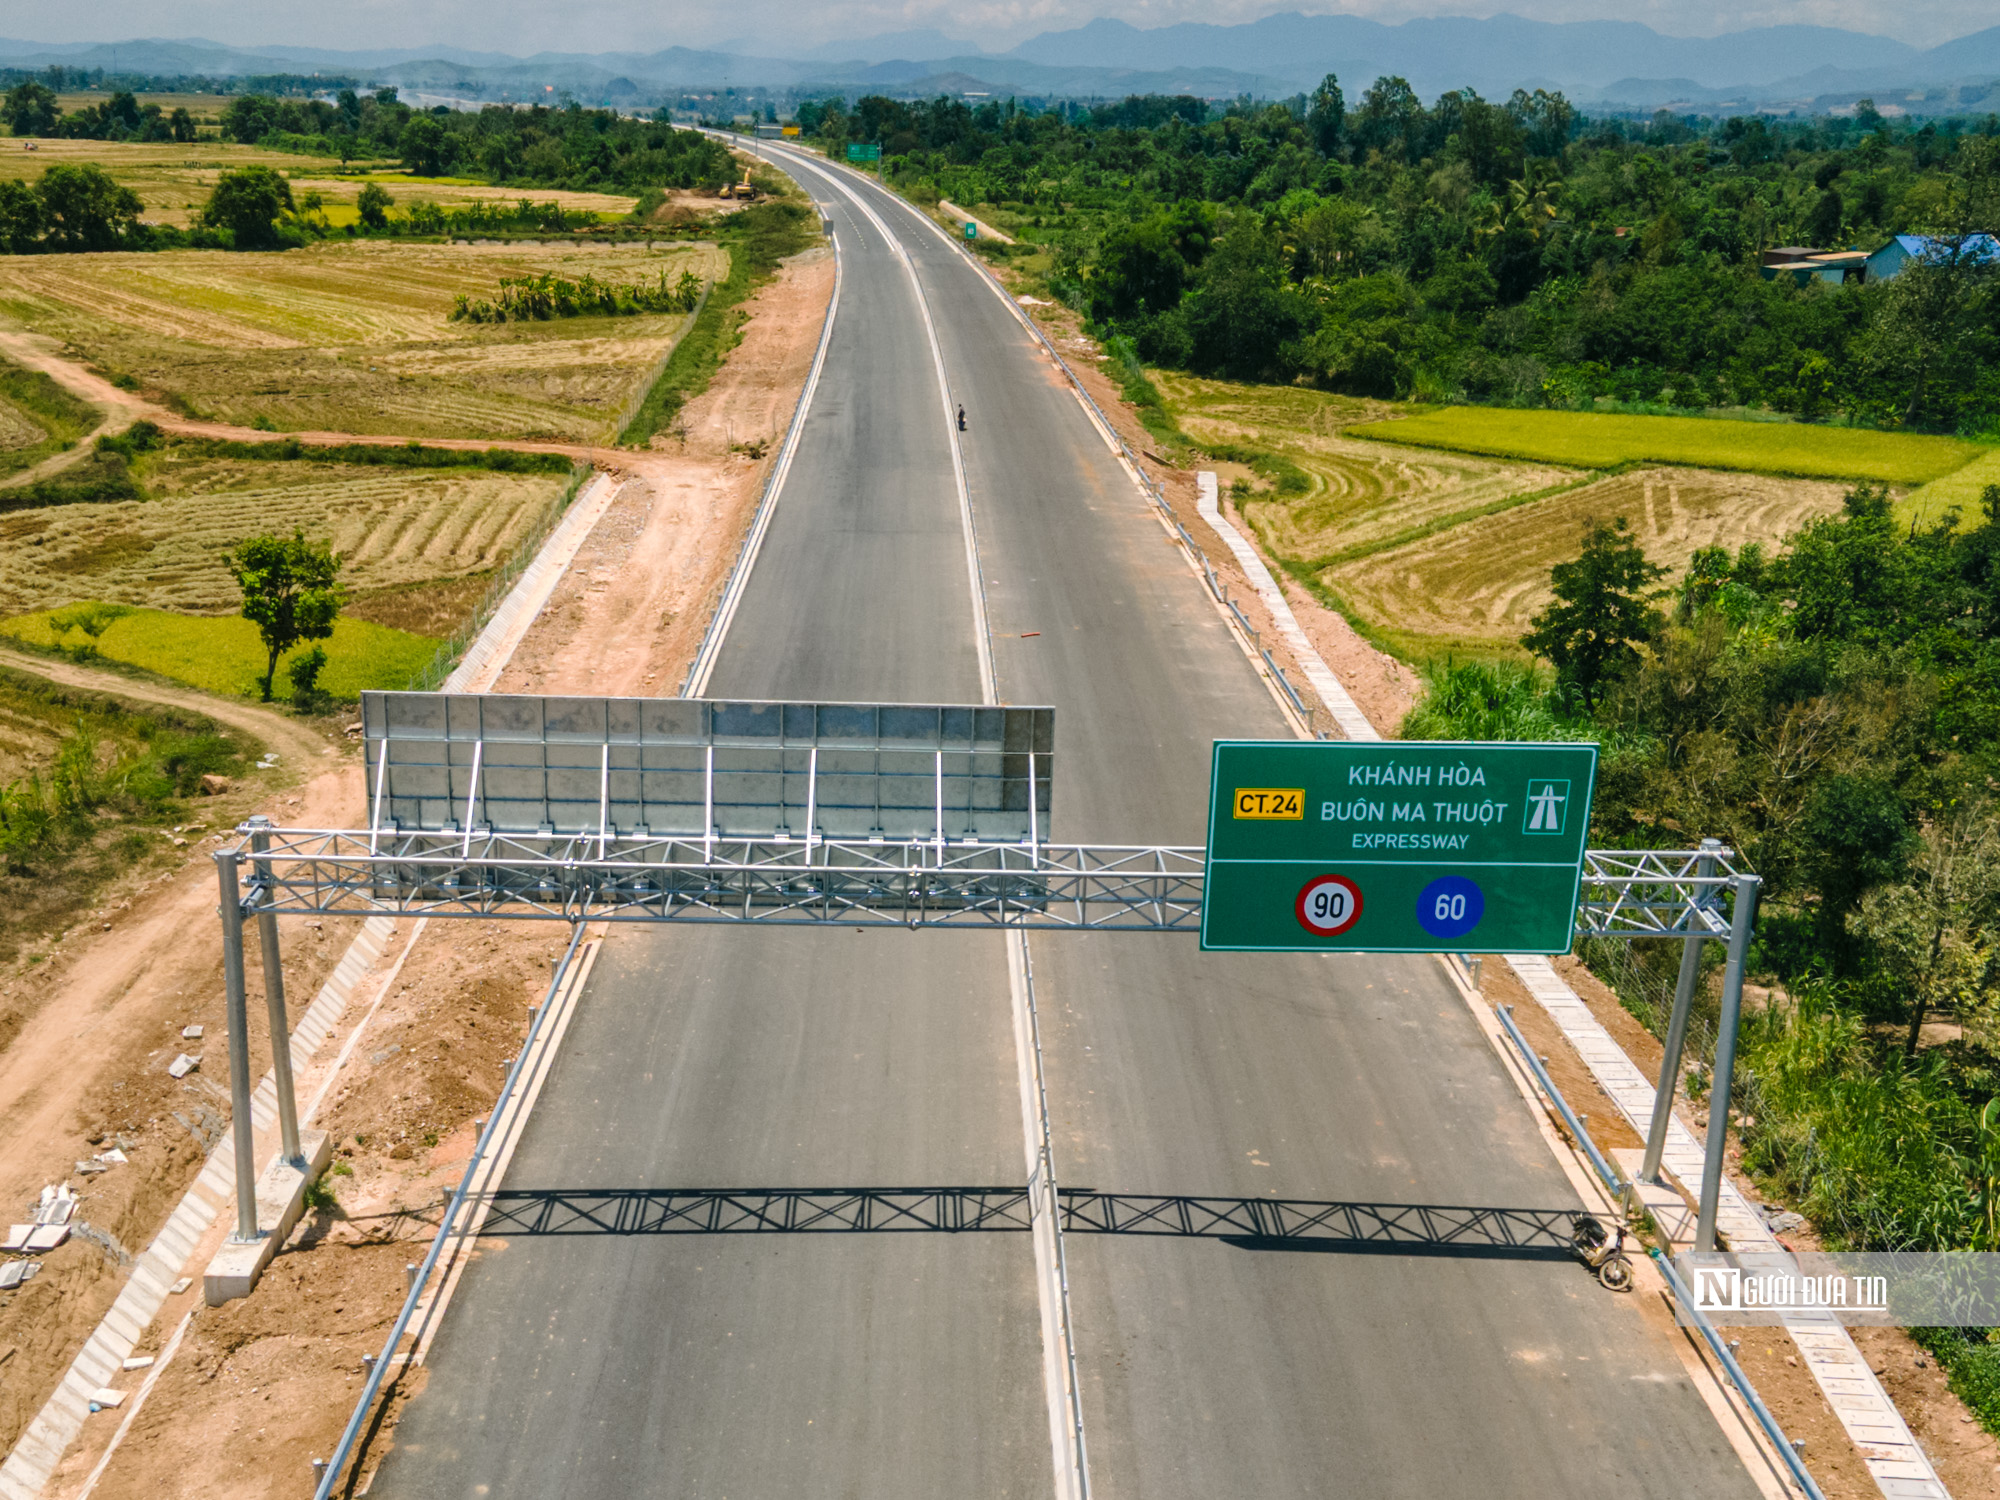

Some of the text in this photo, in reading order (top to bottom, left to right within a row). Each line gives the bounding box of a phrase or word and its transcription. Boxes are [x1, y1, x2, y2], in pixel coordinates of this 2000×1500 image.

[1348, 761, 1486, 786] KHÁNH HÒA
[1239, 794, 1298, 814] CT.24
[1321, 798, 1508, 827] BUÔN MA THUỘT
[1352, 834, 1469, 849] EXPRESSWAY
[1314, 893, 1344, 918] 90
[1435, 894, 1466, 921] 60
